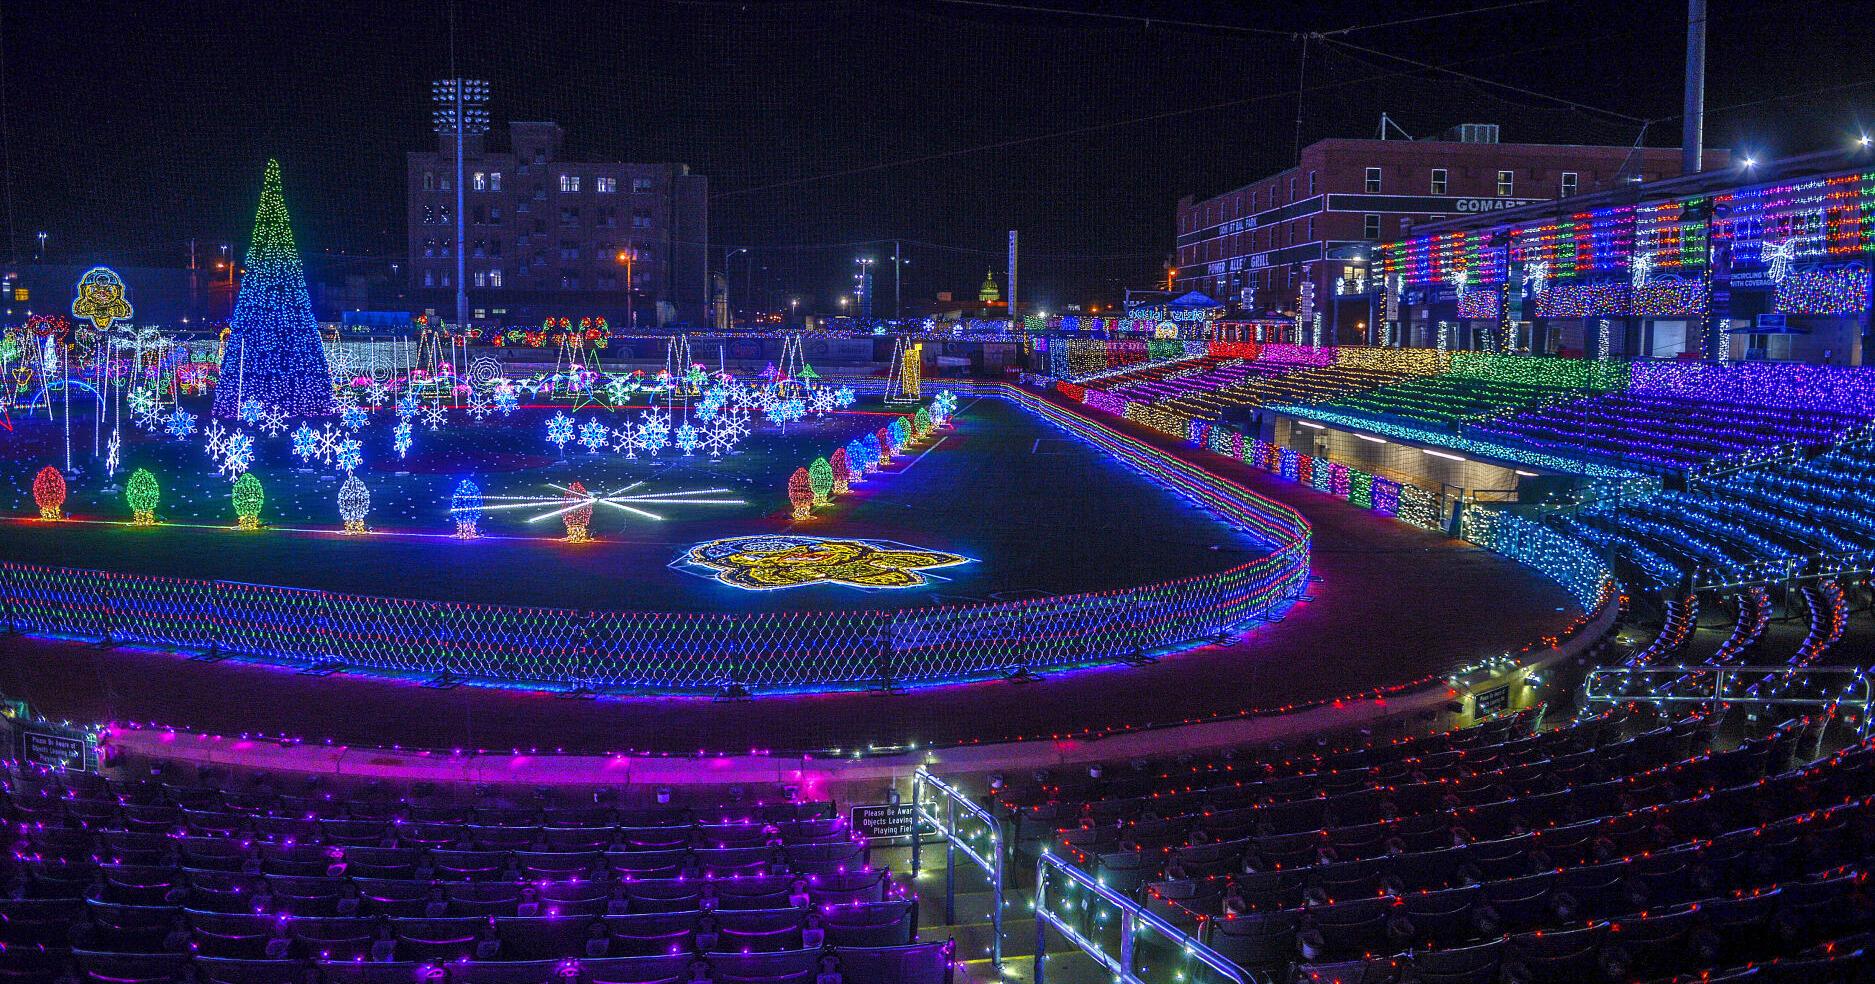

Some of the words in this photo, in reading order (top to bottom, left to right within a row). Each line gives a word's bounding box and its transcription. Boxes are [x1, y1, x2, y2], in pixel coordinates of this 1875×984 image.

[1208, 262, 1226, 275] POWER
[1251, 254, 1269, 268] GRILL
[863, 818, 886, 827] Objects
[888, 817, 913, 825] Leaving
[874, 827, 897, 835] Playing
